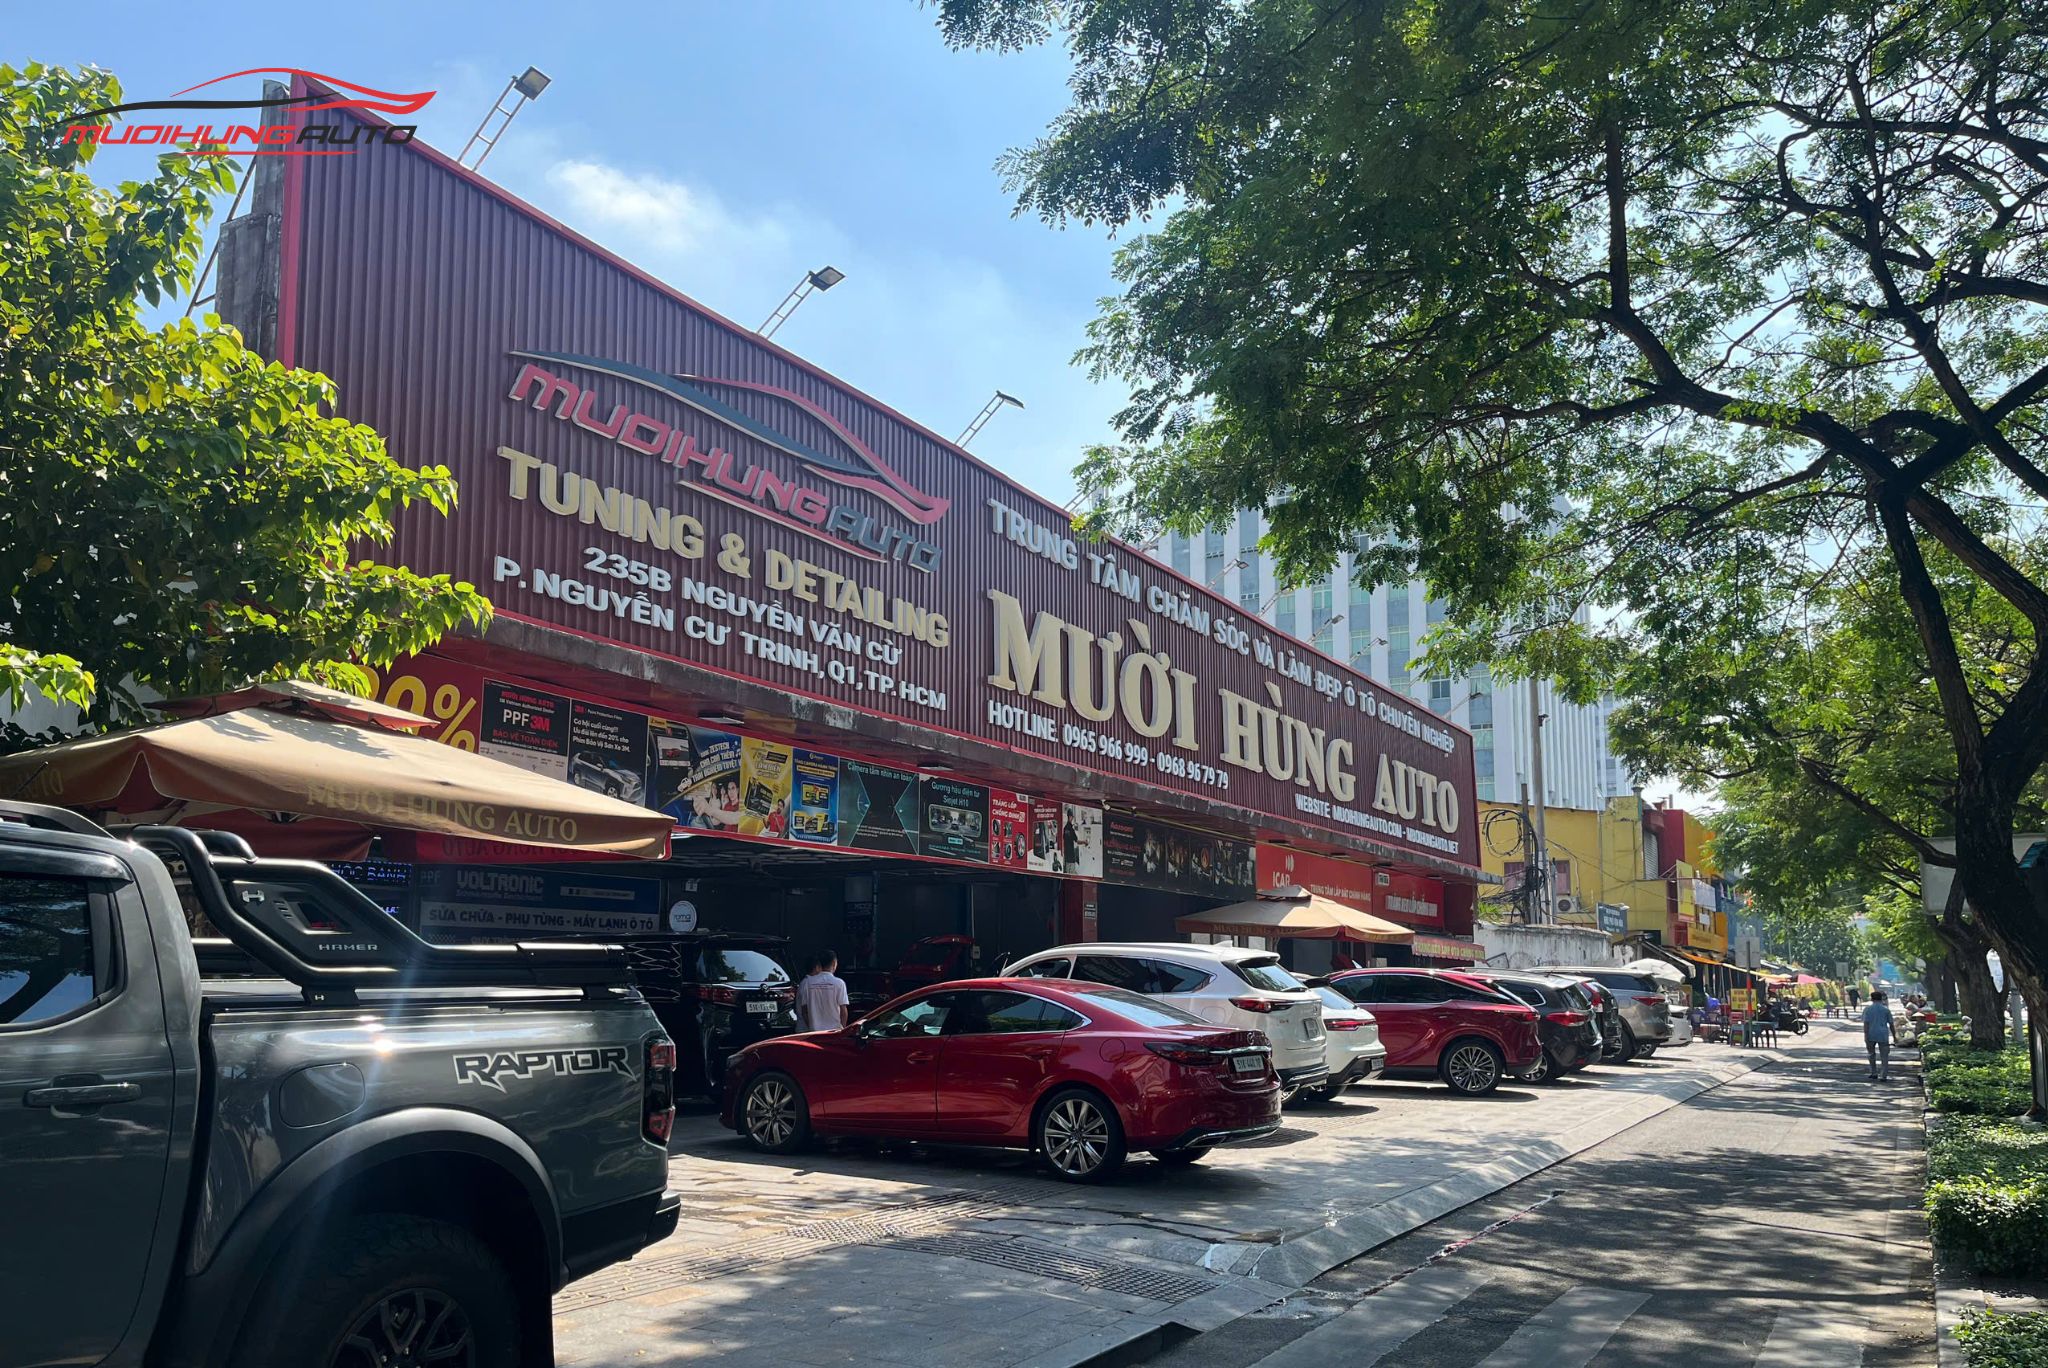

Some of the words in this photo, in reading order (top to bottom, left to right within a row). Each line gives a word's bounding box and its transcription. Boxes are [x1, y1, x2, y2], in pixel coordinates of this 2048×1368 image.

[497, 446, 704, 559] TUNING
[717, 533, 751, 579] &
[765, 549, 949, 648] DETAILING
[533, 568, 674, 631] NGUYỄN
[684, 615, 731, 646] CƯ
[583, 546, 672, 592] 235B
[681, 577, 804, 637] NGUYỄN
[809, 620, 861, 655] VĂN
[866, 638, 902, 666] CỪ
[987, 499, 1078, 571] TRUNG
[1087, 553, 1140, 604] TÂM
[1147, 585, 1210, 637] CHĂM
[1213, 617, 1249, 656] SÓC
[1252, 634, 1275, 670] VÀ
[1277, 650, 1312, 687] LÀM
[1314, 670, 1342, 703] ĐẸP
[1343, 681, 1356, 707] Ô
[1358, 690, 1377, 717] TÔ
[1377, 702, 1421, 739] CHUYÊN
[1420, 723, 1456, 758] NGHIỆP
[354, 665, 475, 755] 0%
[503, 708, 530, 727] PPF
[530, 714, 551, 732] 3M
[987, 589, 1199, 751] MƯỜI
[1218, 681, 1356, 803] HÙNG
[1373, 753, 1459, 834] AUTO
[1063, 723, 1096, 752] 0965
[1098, 735, 1123, 760] 966
[1124, 743, 1148, 767] 999
[1156, 752, 1185, 777] 0968
[504, 810, 578, 842] AUTO
[429, 903, 456, 921] SỬA
[459, 907, 495, 923] CHỮA
[533, 912, 564, 927] TÙNG
[573, 916, 596, 928] MÁY
[599, 918, 627, 932] LẠNH
[453, 1046, 637, 1093] RAPTOR
